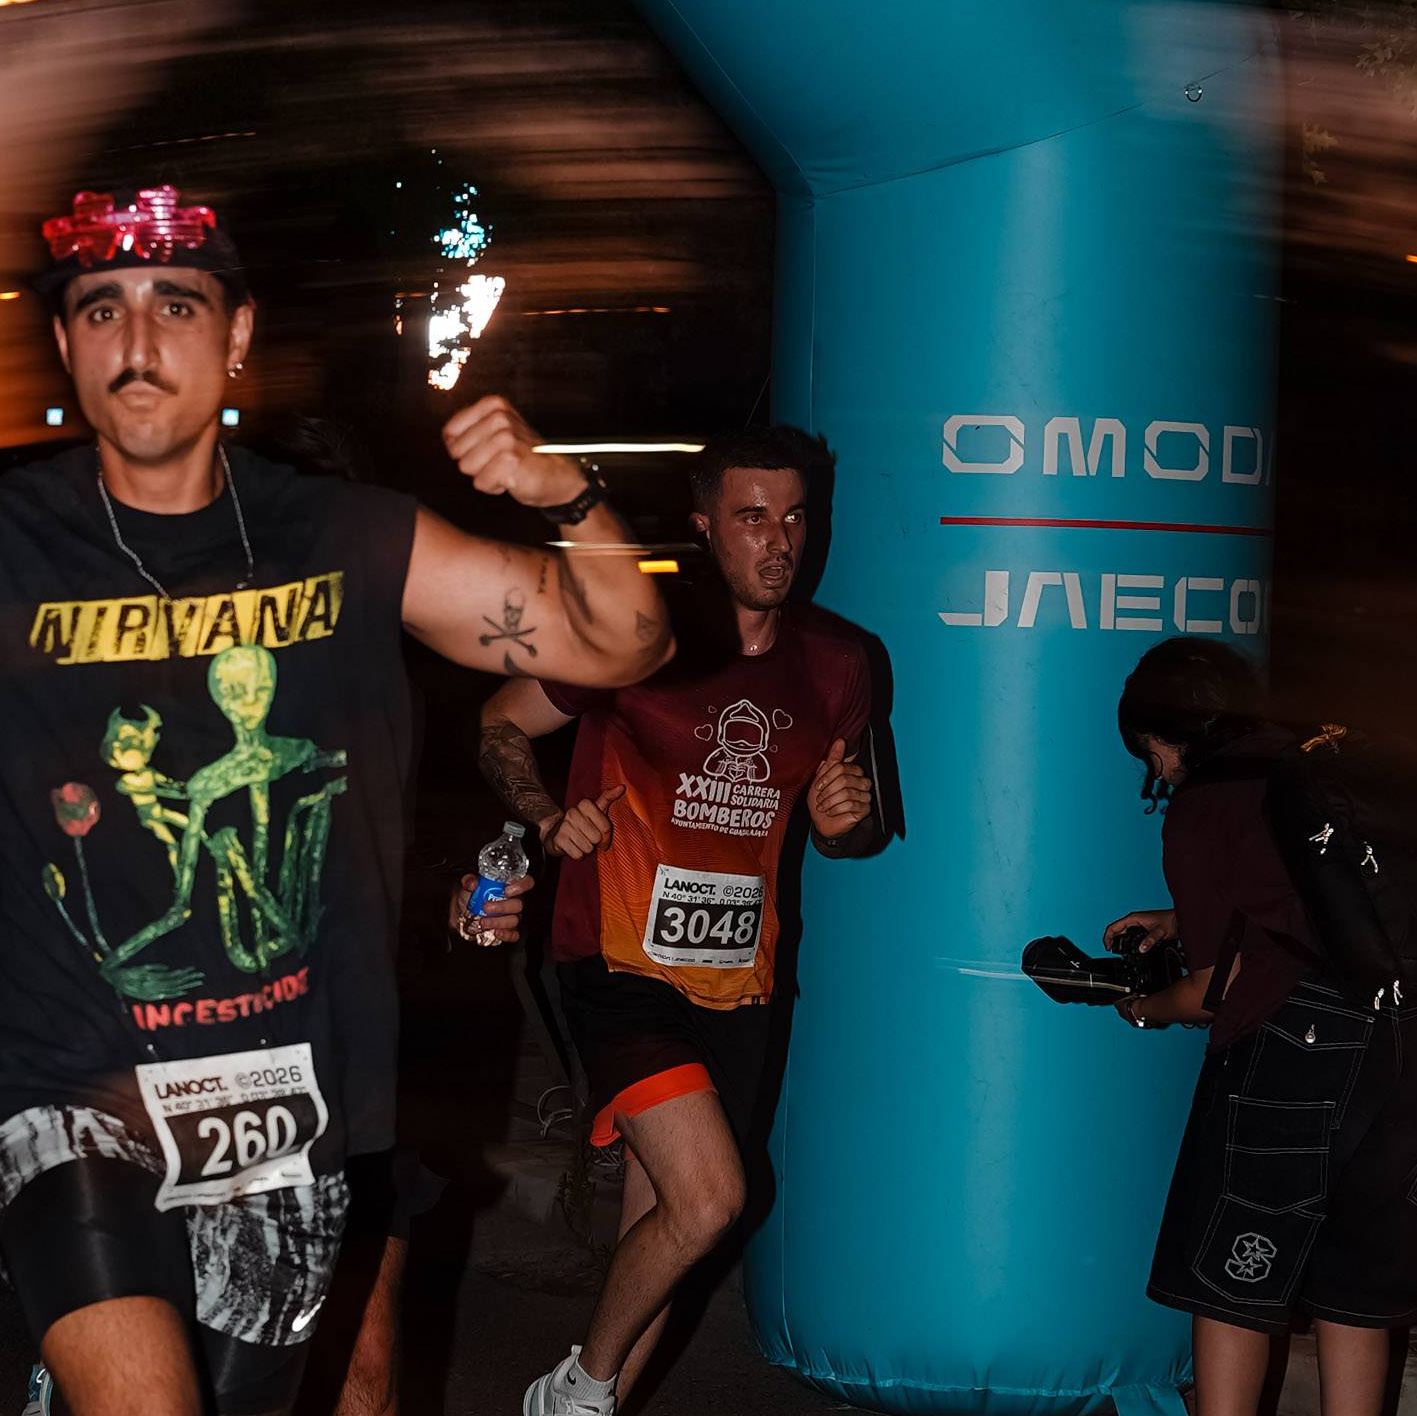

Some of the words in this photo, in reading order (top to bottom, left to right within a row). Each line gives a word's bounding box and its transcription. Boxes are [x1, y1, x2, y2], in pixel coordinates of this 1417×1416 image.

[32, 571, 344, 665] NIRVANA
[675, 772, 732, 804] XXIII
[732, 784, 781, 800] CARRERA
[730, 794, 779, 811] SOLIDARIA
[673, 799, 776, 830] BOMBEROS
[664, 878, 716, 895] LANOCT.
[660, 906, 756, 945] 3048
[154, 1077, 229, 1100] LANOCT.
[197, 1105, 298, 1177] 260
